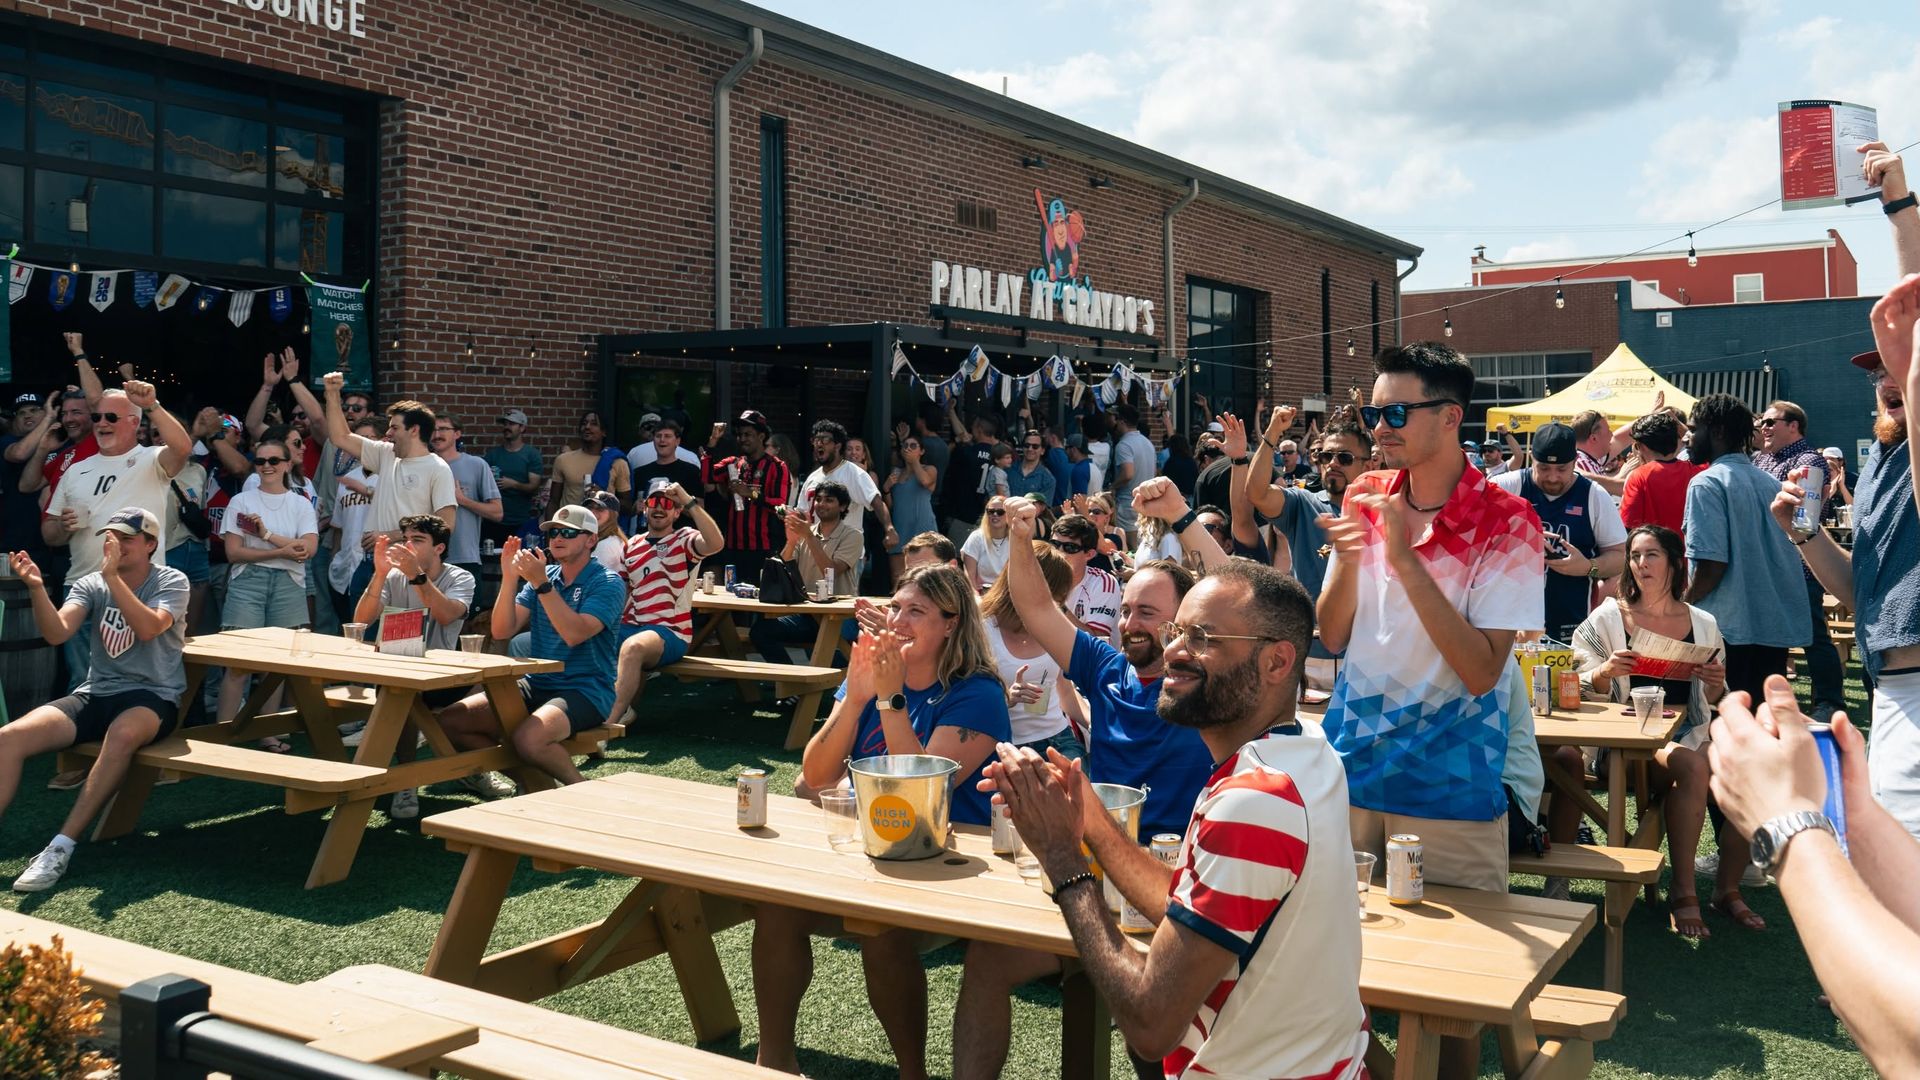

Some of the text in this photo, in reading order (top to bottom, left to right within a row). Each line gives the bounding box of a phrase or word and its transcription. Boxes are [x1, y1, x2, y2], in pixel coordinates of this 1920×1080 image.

[322, 287, 355, 299] WATCH
[931, 260, 1024, 316] PARLAY
[1030, 280, 1055, 321] AT
[1062, 285, 1155, 336] GRAYBO'S
[317, 298, 364, 310] MATCHES
[330, 312, 355, 321] HERE
[16, 393, 37, 403] USA
[93, 475, 117, 496] 10
[210, 508, 225, 519] US
[105, 609, 124, 630] US
[874, 808, 907, 817] HIGH
[873, 818, 911, 828] NOON
